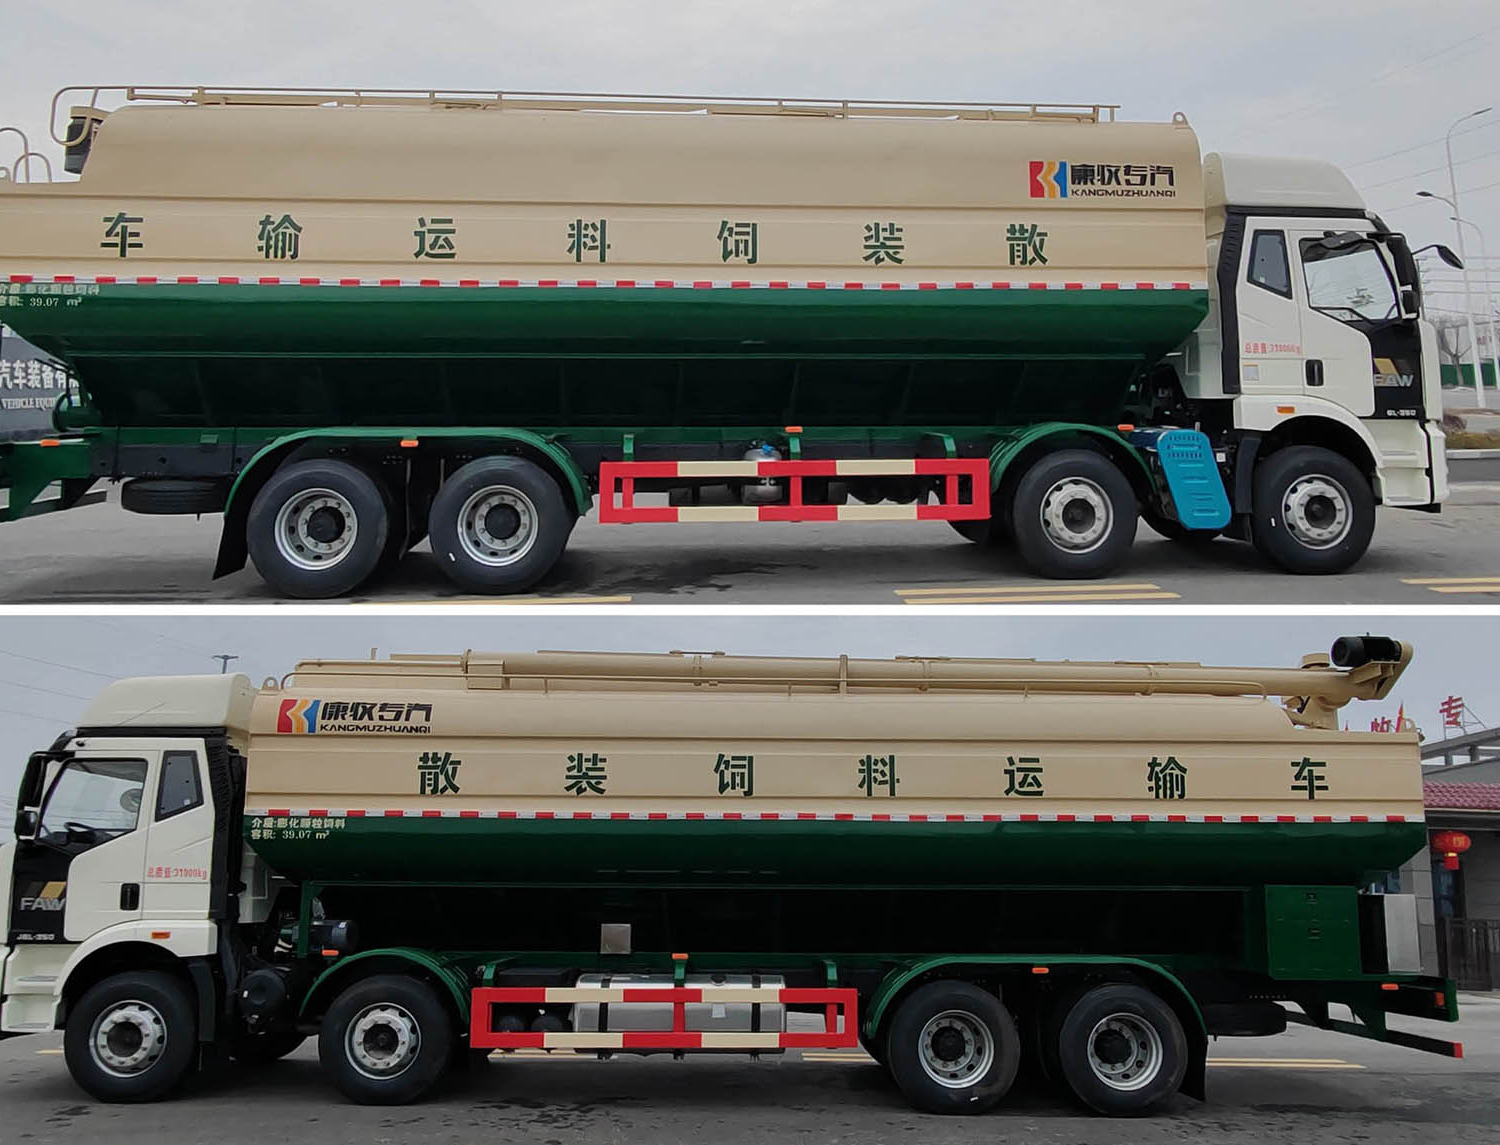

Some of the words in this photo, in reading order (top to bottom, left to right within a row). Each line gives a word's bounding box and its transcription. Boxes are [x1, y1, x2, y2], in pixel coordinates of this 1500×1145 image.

[1071, 189, 1176, 197] KANGMUZHUANQI
[320, 724, 431, 733] KANGMUZHUANQI
[282, 830, 311, 839] 39.07
[20, 897, 66, 910] FAW
